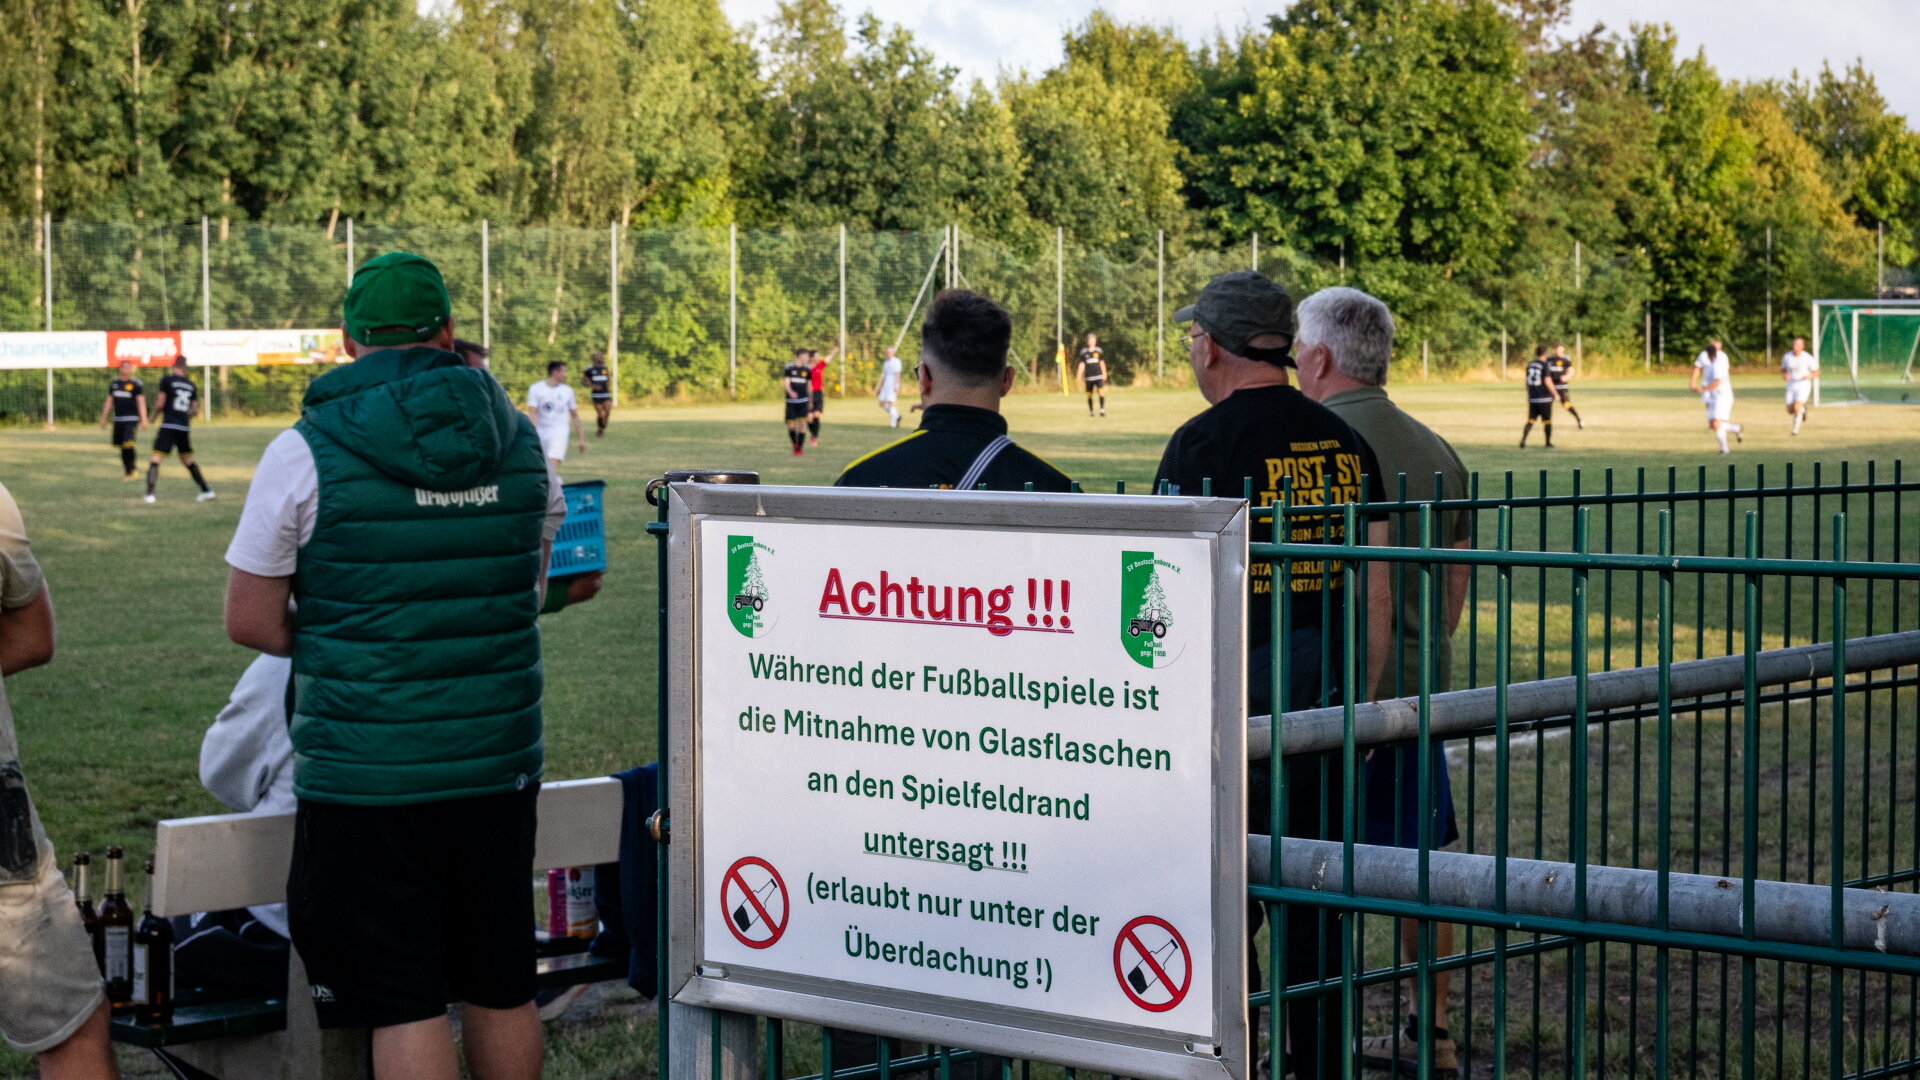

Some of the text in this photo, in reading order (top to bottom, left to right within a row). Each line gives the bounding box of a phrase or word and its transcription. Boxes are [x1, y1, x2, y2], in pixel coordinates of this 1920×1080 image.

[1264, 453, 1361, 490] POST SV
[1127, 563, 1134, 572] SV
[819, 568, 1072, 635] Achtung !!!
[749, 653, 1159, 711] Während der Fußballspiele ist
[738, 706, 1171, 771] die Mitnahme von Glasflaschen
[807, 770, 1090, 821] an den Spielfeldrand
[864, 832, 1028, 872] untersagt !!!
[807, 871, 1100, 937] (erlaubt nur unter der
[844, 929, 1053, 993] Überdachung !)
